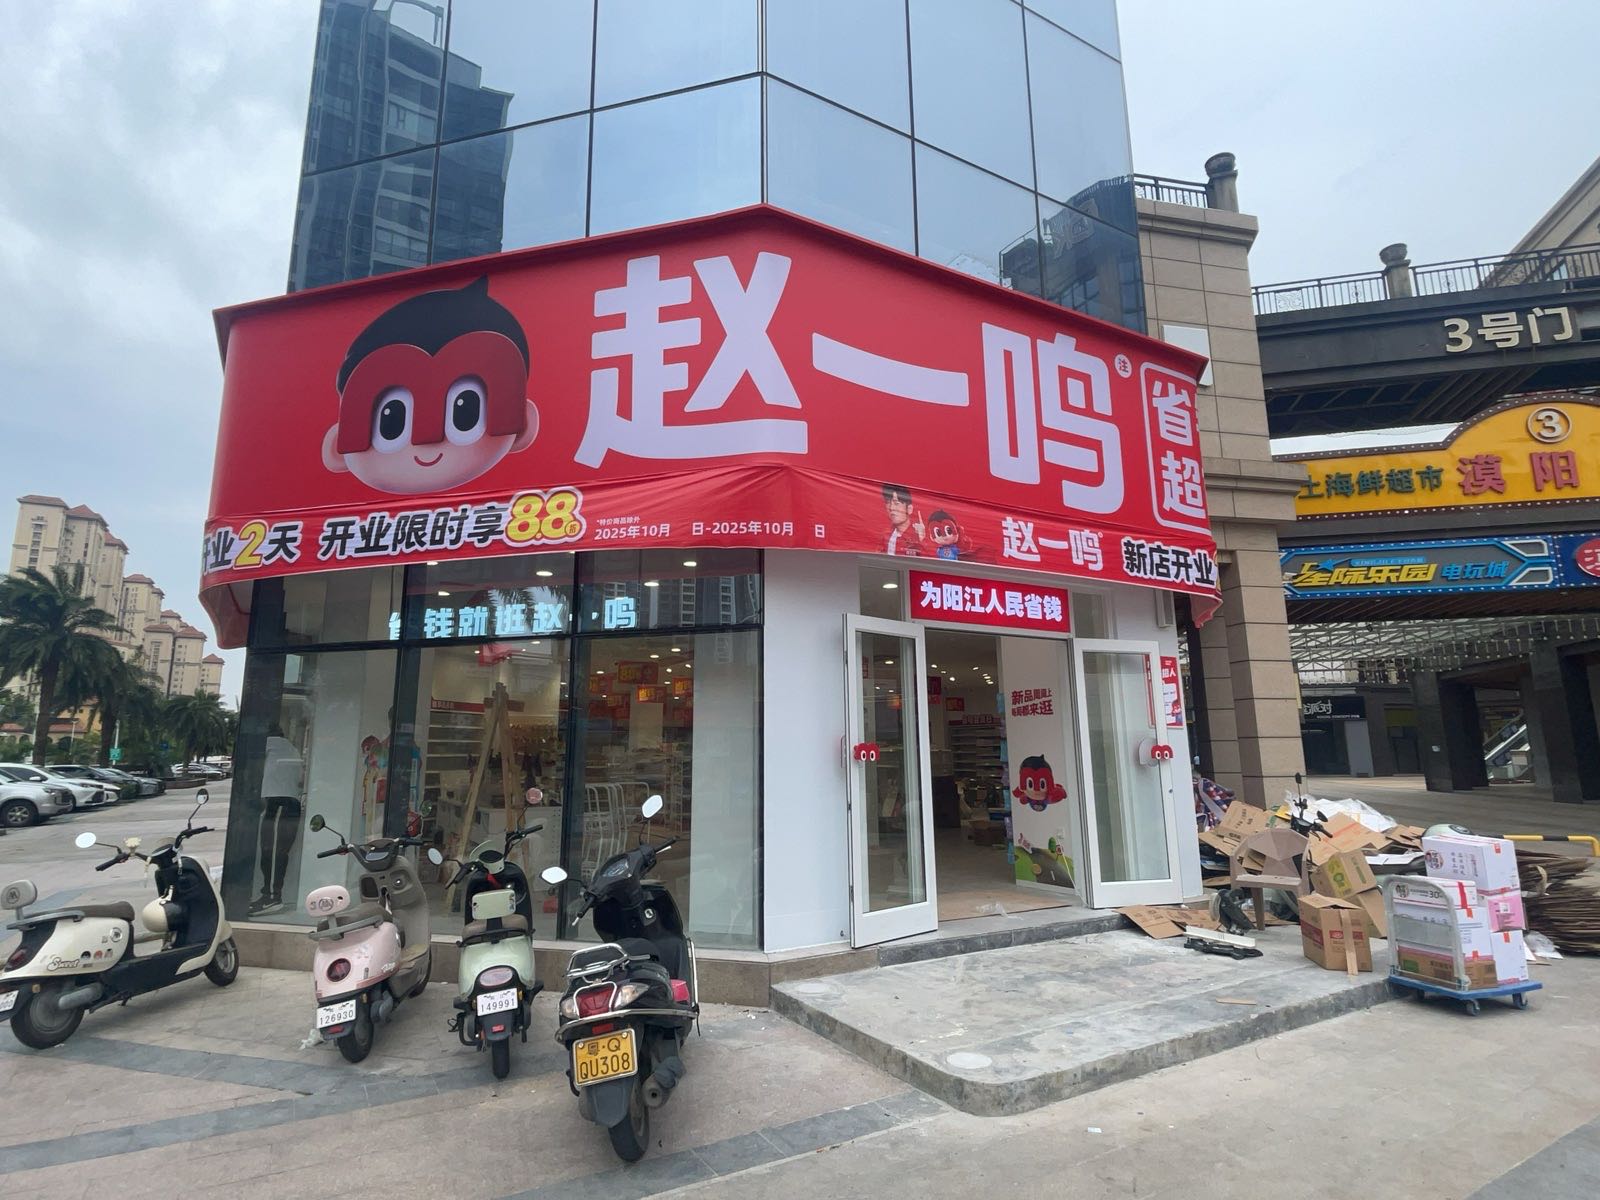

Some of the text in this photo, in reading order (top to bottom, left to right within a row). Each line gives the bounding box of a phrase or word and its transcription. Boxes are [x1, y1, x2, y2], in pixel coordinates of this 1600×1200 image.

[1444, 306, 1573, 352] 3号门
[573, 251, 1125, 513] 赵一鸣
[594, 523, 671, 540] 2025年10月
[815, 524, 825, 538] 日
[1001, 516, 1216, 587] 赵一鸣 新店开业
[1441, 561, 1509, 581] 电玩城
[920, 581, 1063, 622] 为阳江人民省钱
[320, 1009, 354, 1026] 126930
[481, 998, 515, 1013] 149991
[580, 1052, 631, 1080] QU308
